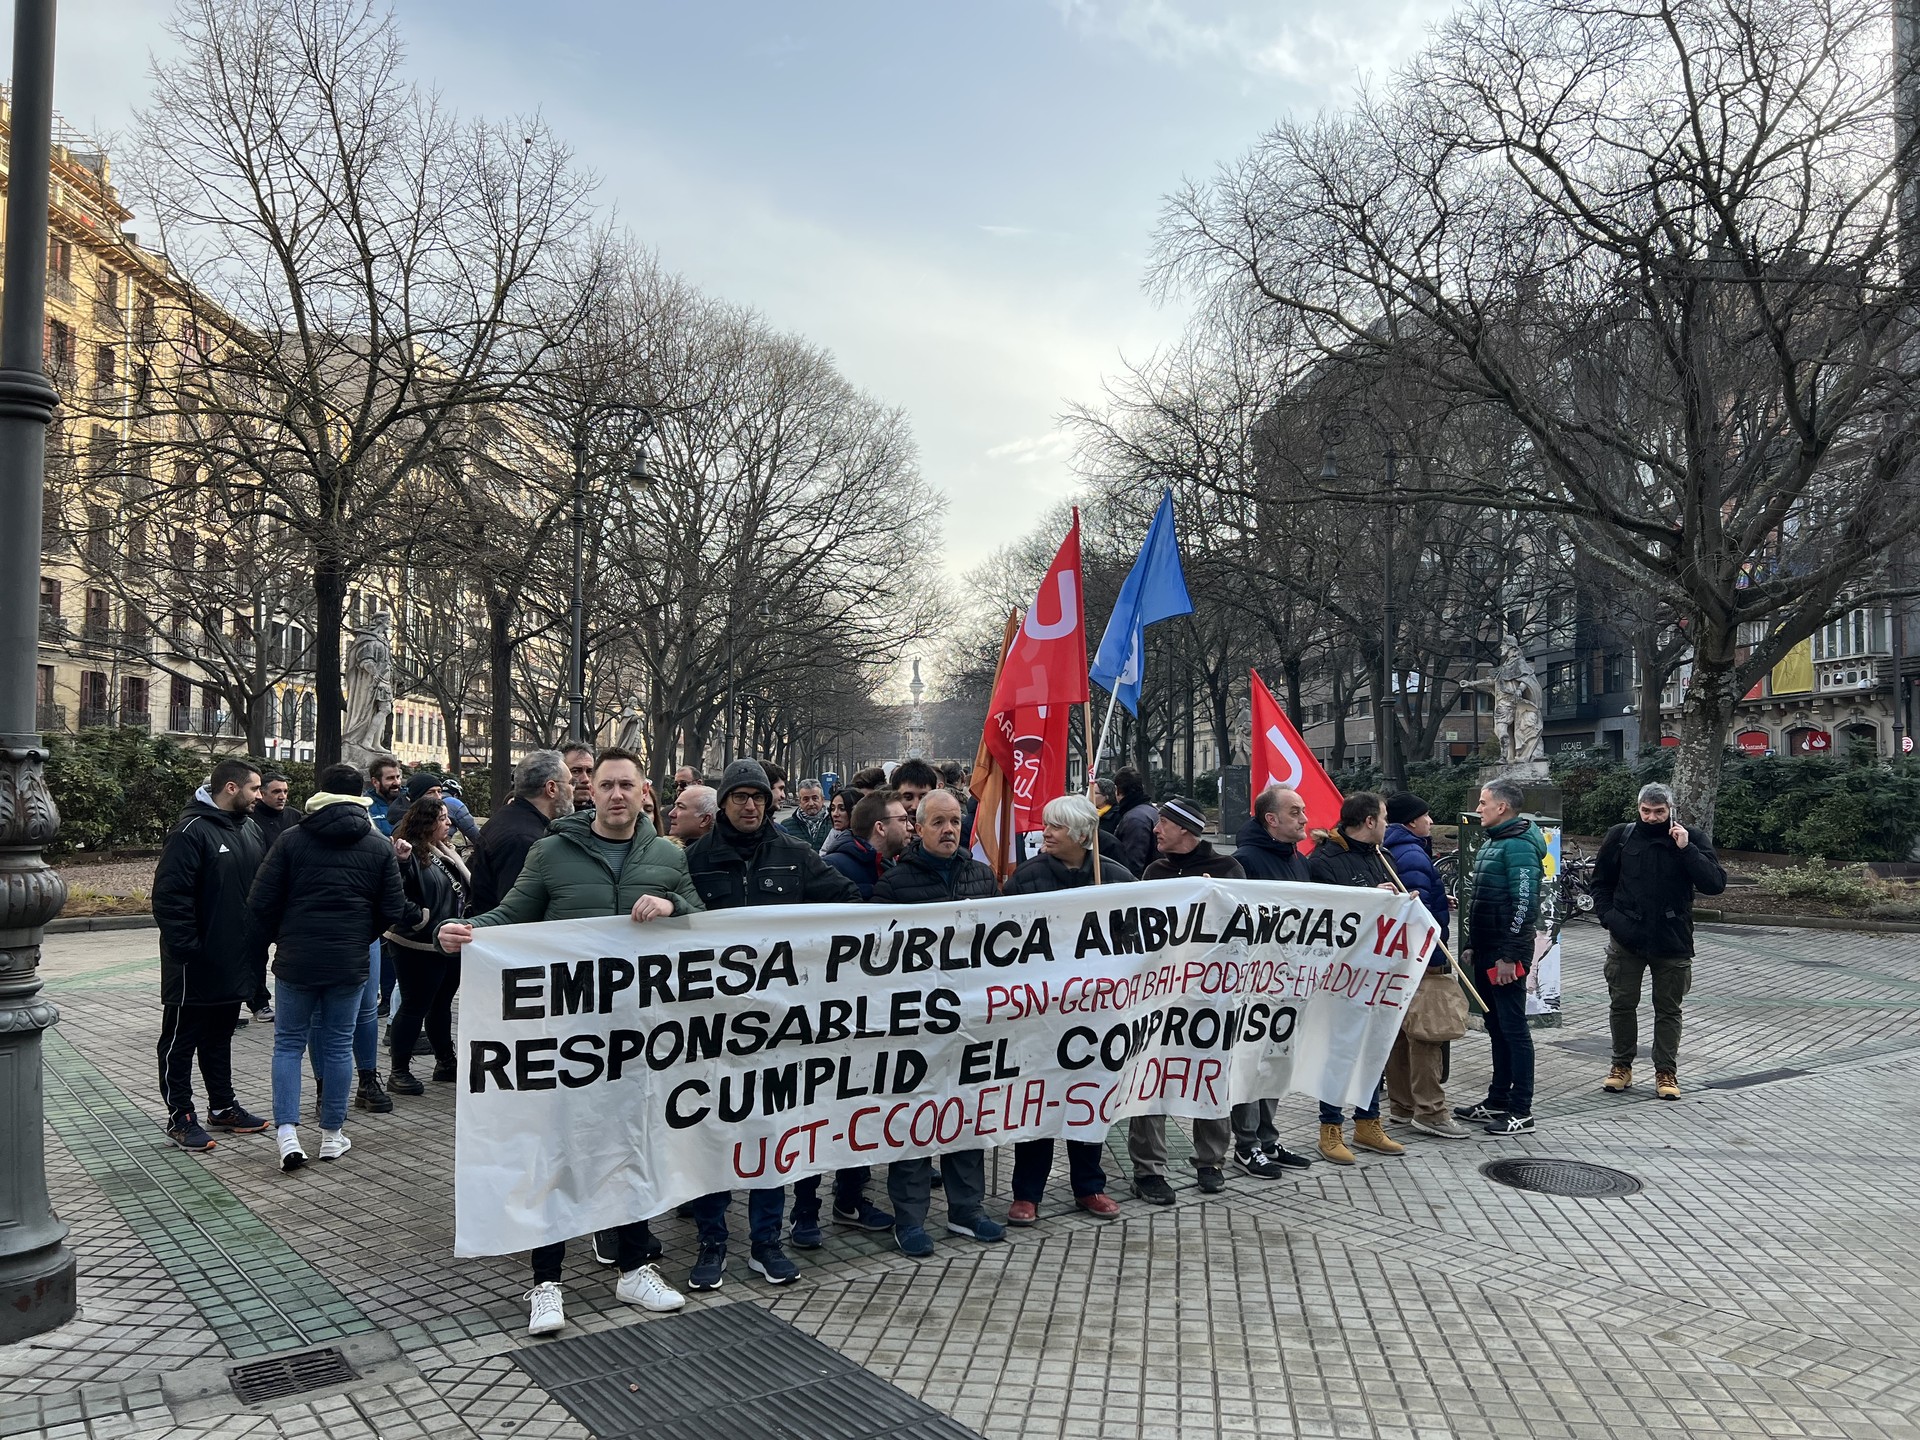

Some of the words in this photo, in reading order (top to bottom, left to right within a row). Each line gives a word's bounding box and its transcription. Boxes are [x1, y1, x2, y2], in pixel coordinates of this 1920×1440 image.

[1744, 743, 1767, 751] Santander
[501, 940, 799, 1021] EMPRESA
[825, 918, 1056, 983] PÚBLICA
[1074, 902, 1362, 960] AMBULANCIAS
[469, 987, 961, 1094] RESPONSABLES
[665, 1049, 928, 1130] CUMPLID
[957, 1037, 1020, 1085] EL
[1056, 1003, 1297, 1072] COMPROMISO
